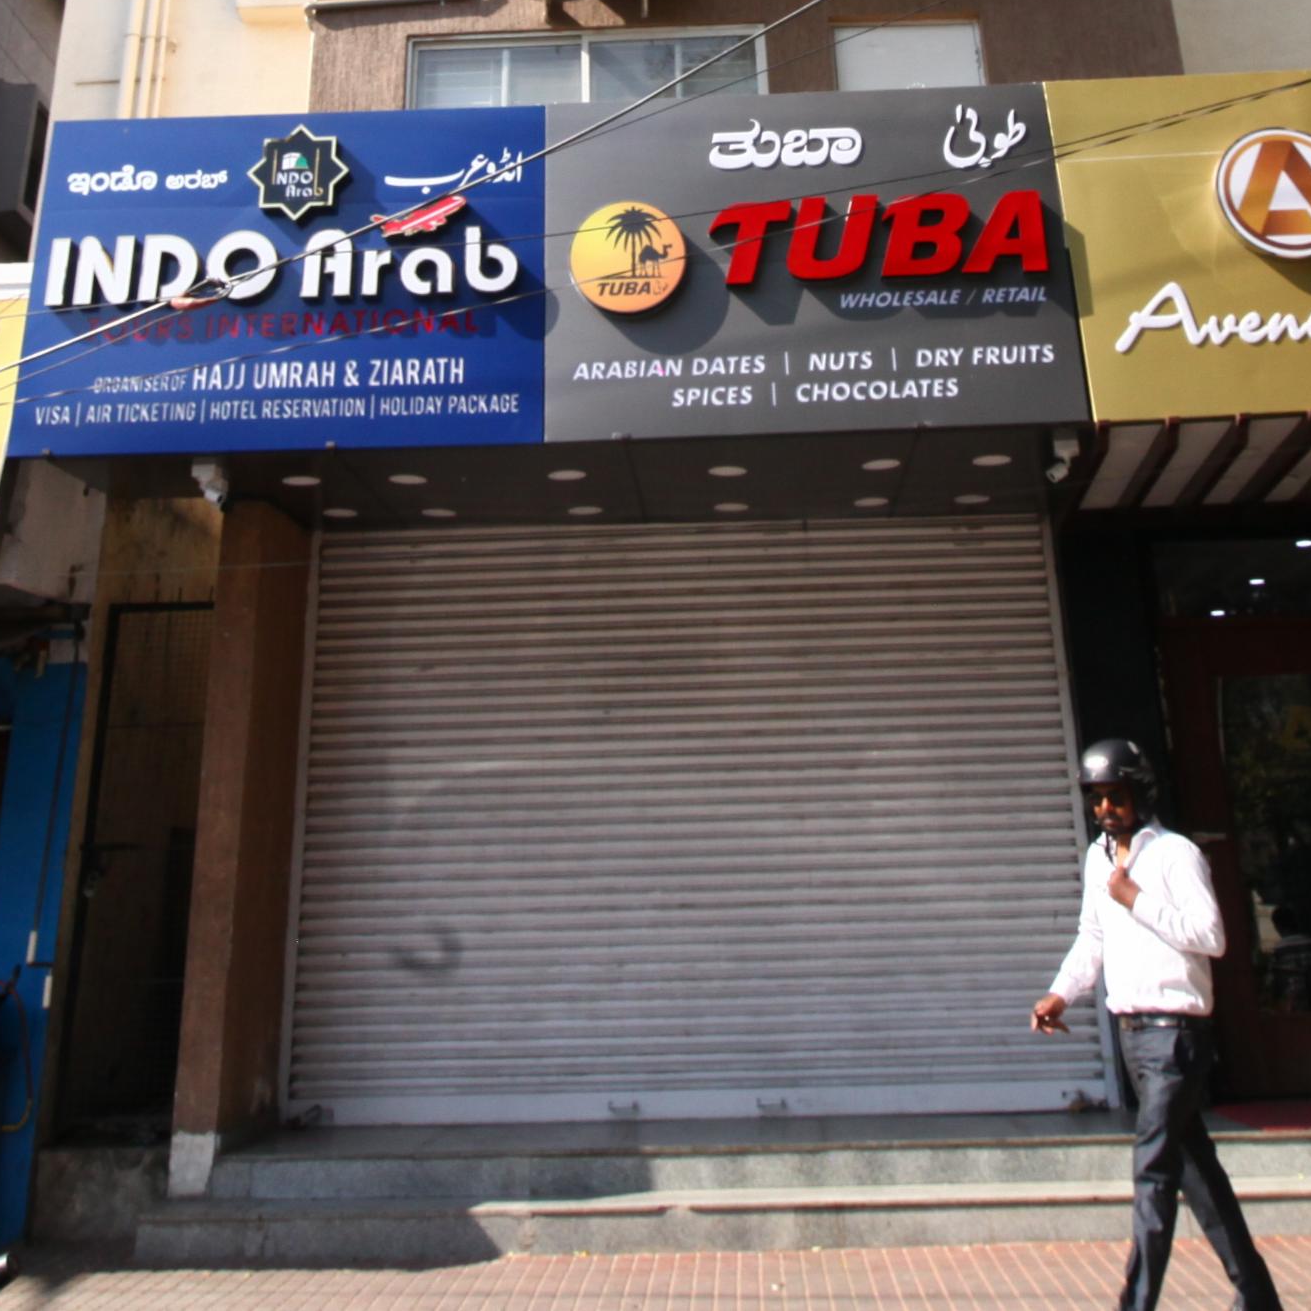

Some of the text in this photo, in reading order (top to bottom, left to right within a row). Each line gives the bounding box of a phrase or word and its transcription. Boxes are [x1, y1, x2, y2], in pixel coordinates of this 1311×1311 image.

[709, 118, 863, 170] ತುಬಾ
[708, 190, 1050, 286] TUBA
[45, 226, 519, 308] INDO Arab
[598, 281, 651, 296] TUBA
[840, 289, 961, 309] WHOLESALE
[982, 286, 1047, 304] RETAIL
[90, 308, 479, 343] TOURS INTERNATIONAL
[193, 363, 246, 390] HAJJ
[253, 360, 336, 389] UMRAH
[343, 360, 360, 387] &
[368, 357, 465, 386] ZIARATH
[573, 344, 1055, 381] ARABIAN DATES NUTS DRY FRUITS
[35, 393, 519, 425] VISA AIR TICKETING HOTEL RESERVATION HOLIDAY PACKAGE
[672, 378, 959, 408] SPICES CHOCOLATES
